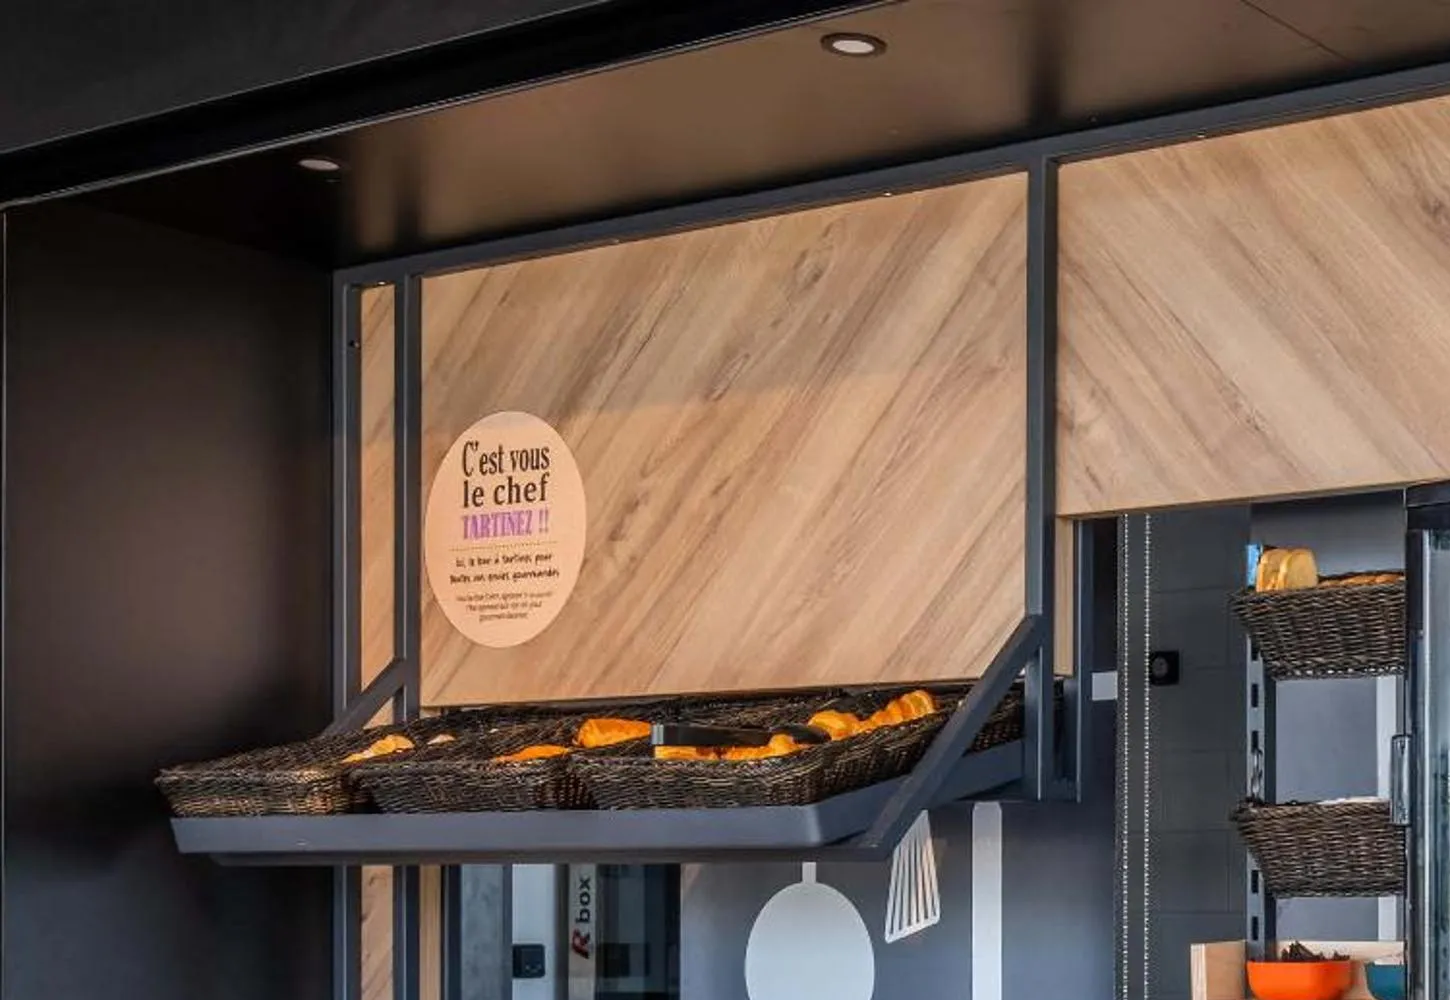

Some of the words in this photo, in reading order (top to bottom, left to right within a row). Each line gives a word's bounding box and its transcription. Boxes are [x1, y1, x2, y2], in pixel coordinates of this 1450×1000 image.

[461, 441, 503, 477] C'est
[510, 446, 550, 473] vous
[463, 480, 484, 508] le
[494, 472, 550, 506] chef
[461, 509, 533, 540] TARTINEZ
[576, 877, 592, 924] box
